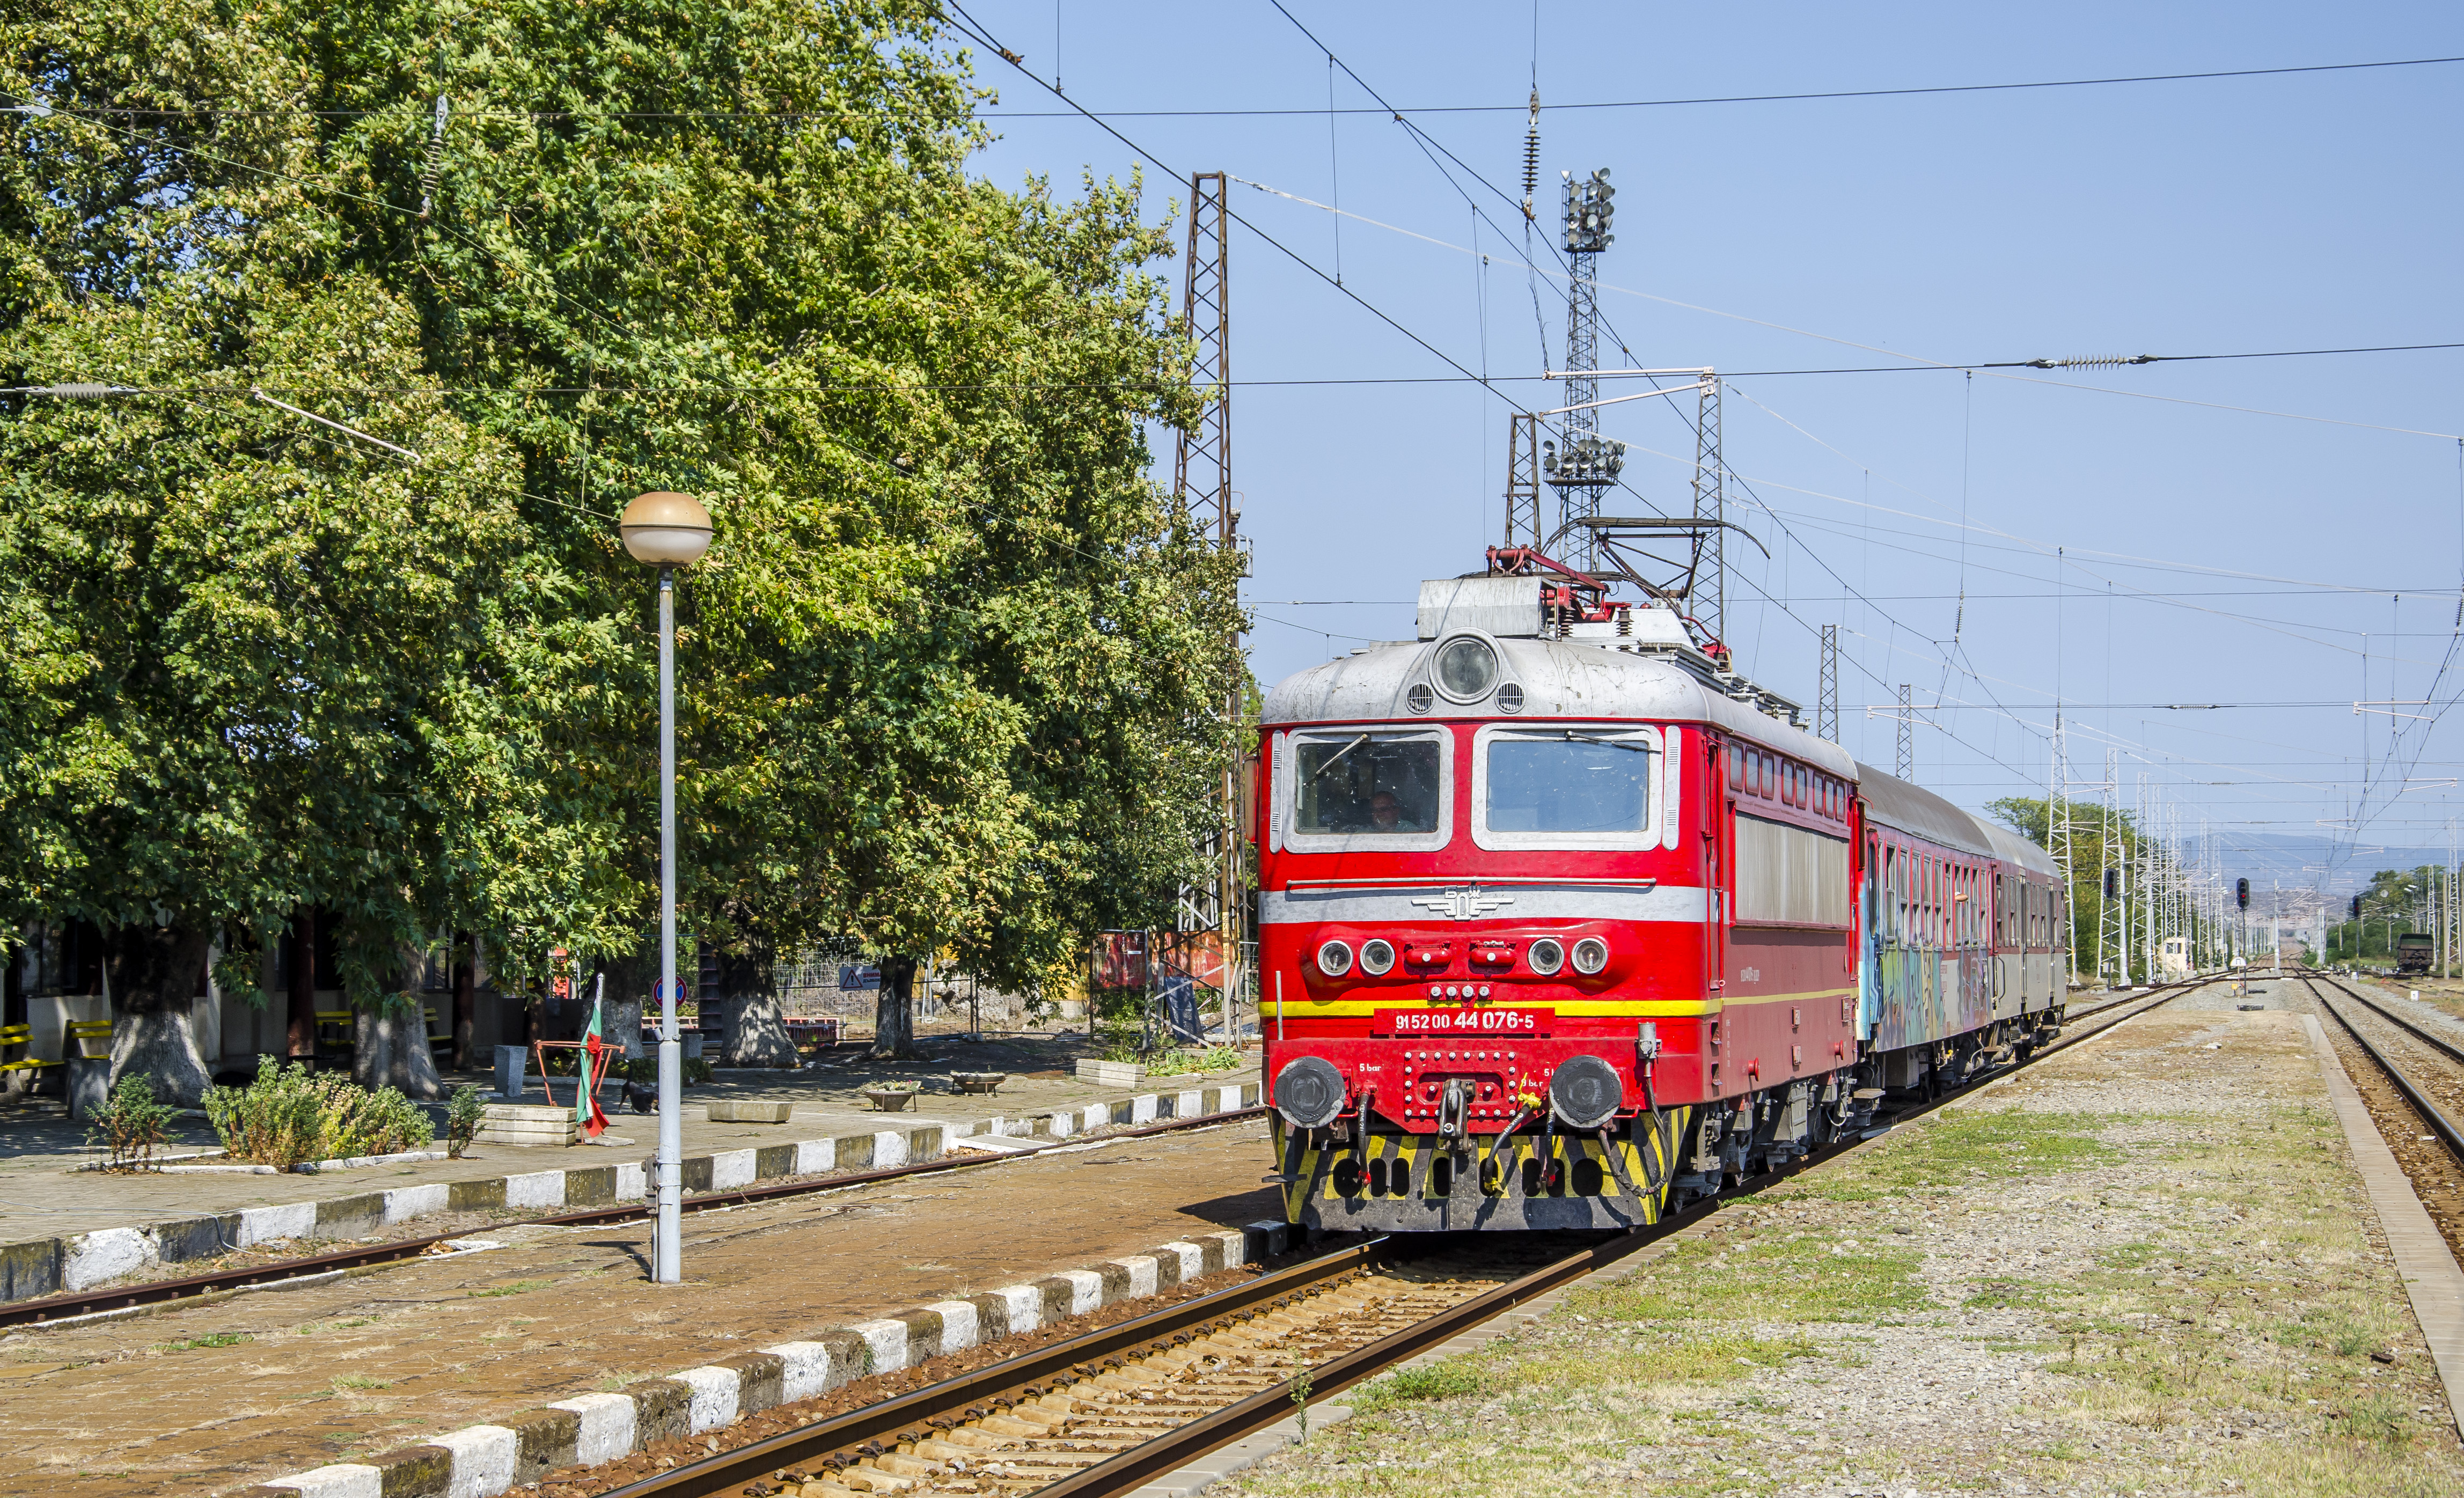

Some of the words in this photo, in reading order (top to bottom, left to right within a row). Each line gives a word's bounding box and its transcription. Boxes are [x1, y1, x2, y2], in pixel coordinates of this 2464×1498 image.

[1454, 1011, 1478, 1029] 44
[1360, 1063, 1365, 1071] 5
[1367, 1063, 1381, 1071] bar
[1544, 1068, 1550, 1076] 5
